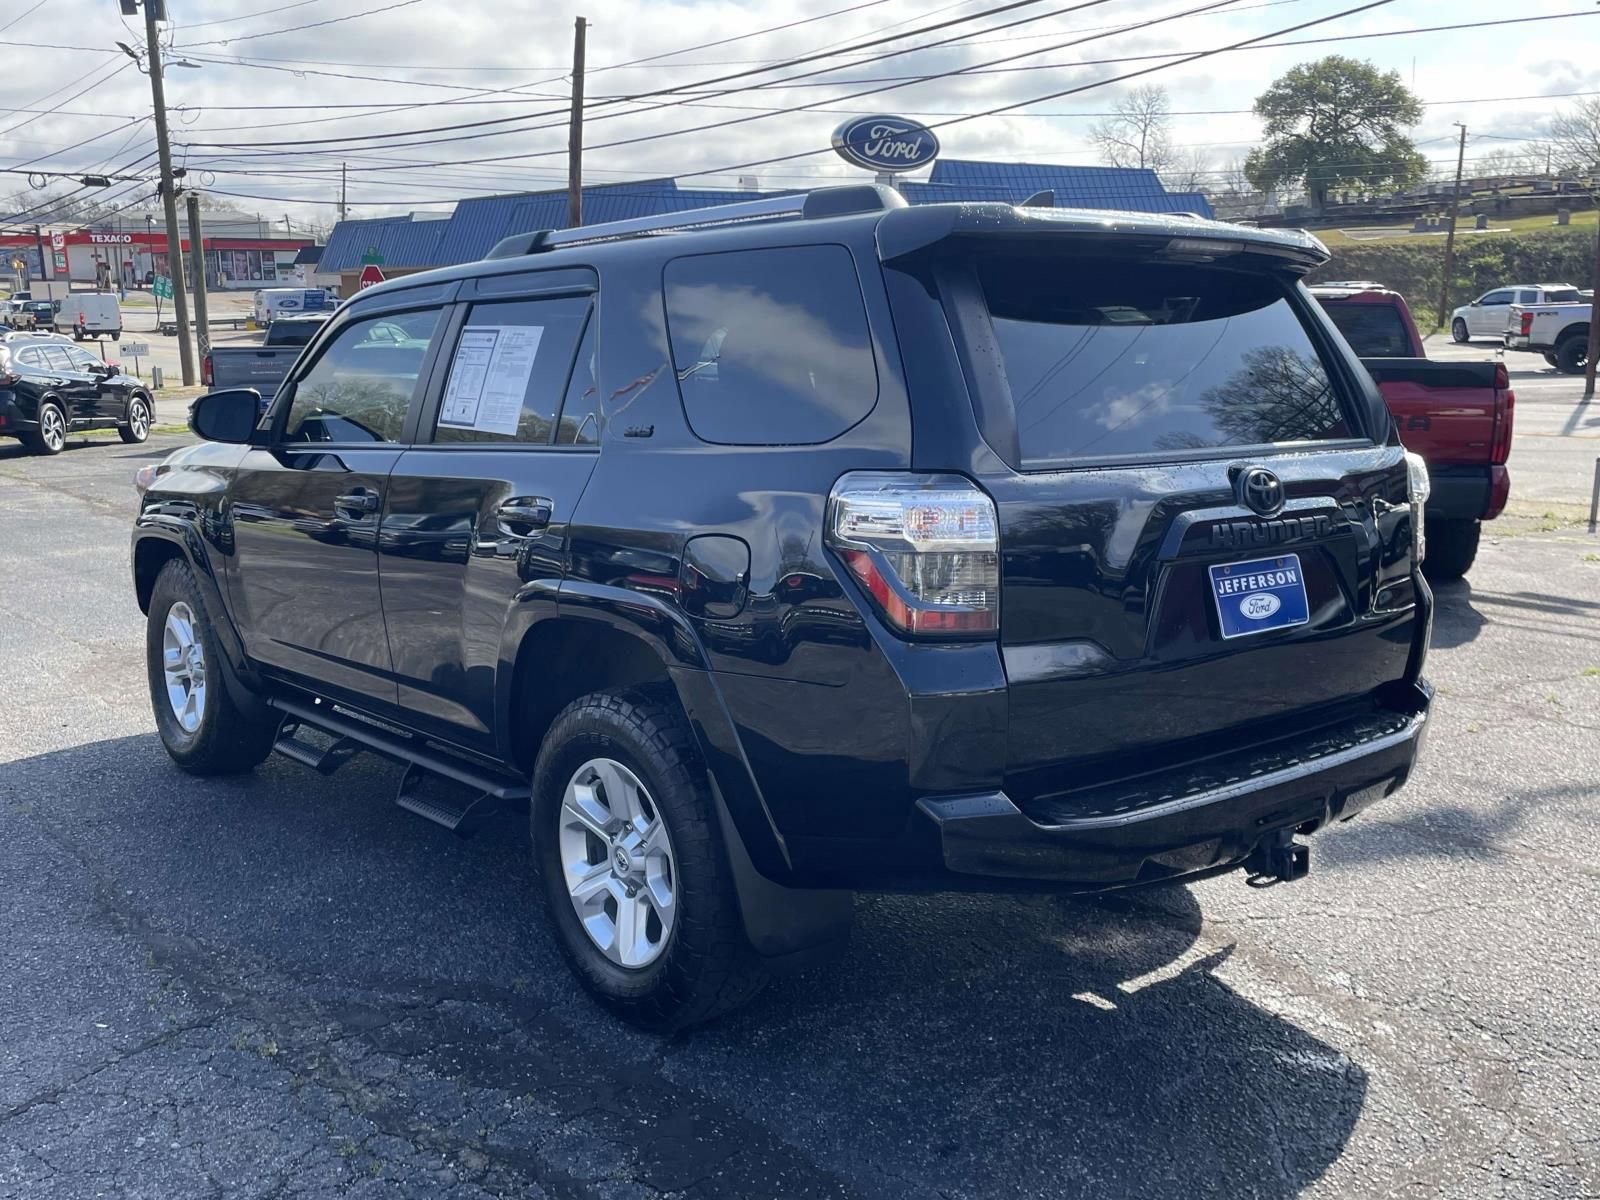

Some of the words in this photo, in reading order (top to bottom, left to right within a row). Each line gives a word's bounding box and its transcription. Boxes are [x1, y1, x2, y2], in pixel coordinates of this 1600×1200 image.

[864, 124, 922, 160] Ford
[90, 234, 132, 243] TEXACO
[1218, 570, 1297, 594] JEFFERSON
[1248, 598, 1272, 615] Ford
